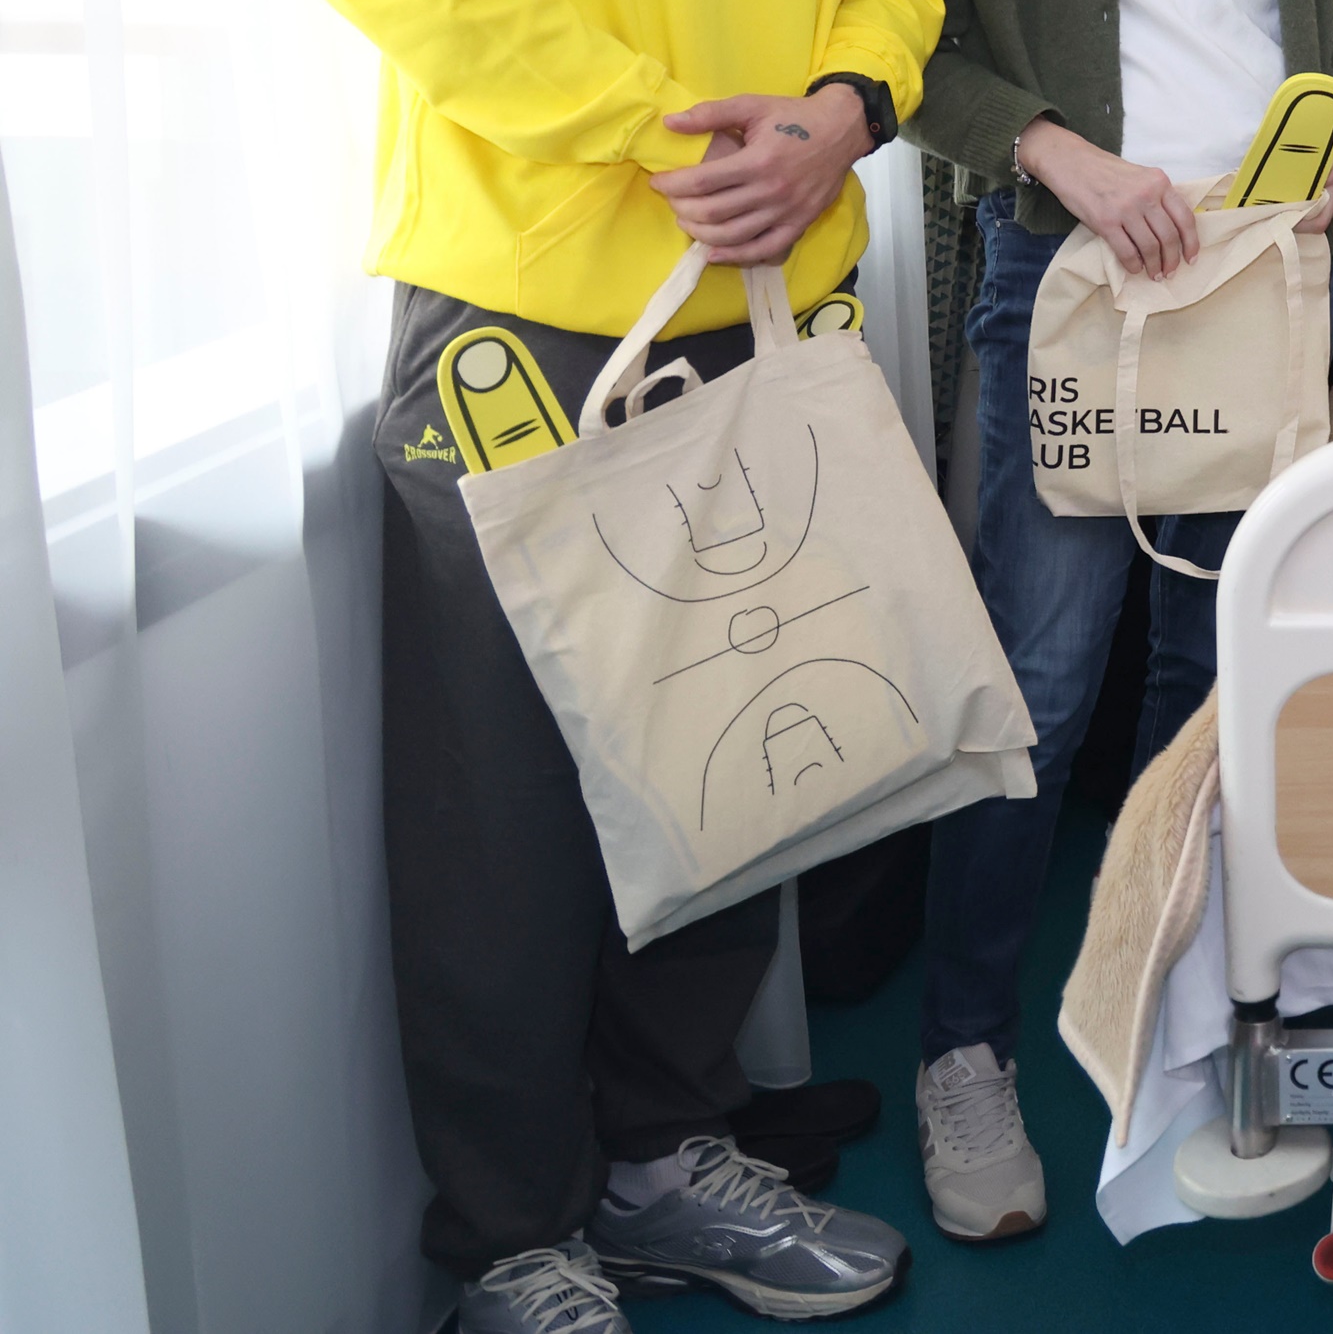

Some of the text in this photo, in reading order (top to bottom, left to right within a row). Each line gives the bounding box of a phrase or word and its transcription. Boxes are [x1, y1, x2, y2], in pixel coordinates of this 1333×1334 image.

[1029, 376, 1079, 403] RIS
[1030, 408, 1229, 436] ASKEBALL
[404, 444, 456, 464] CROSSOVER
[1032, 444, 1091, 469] UB
